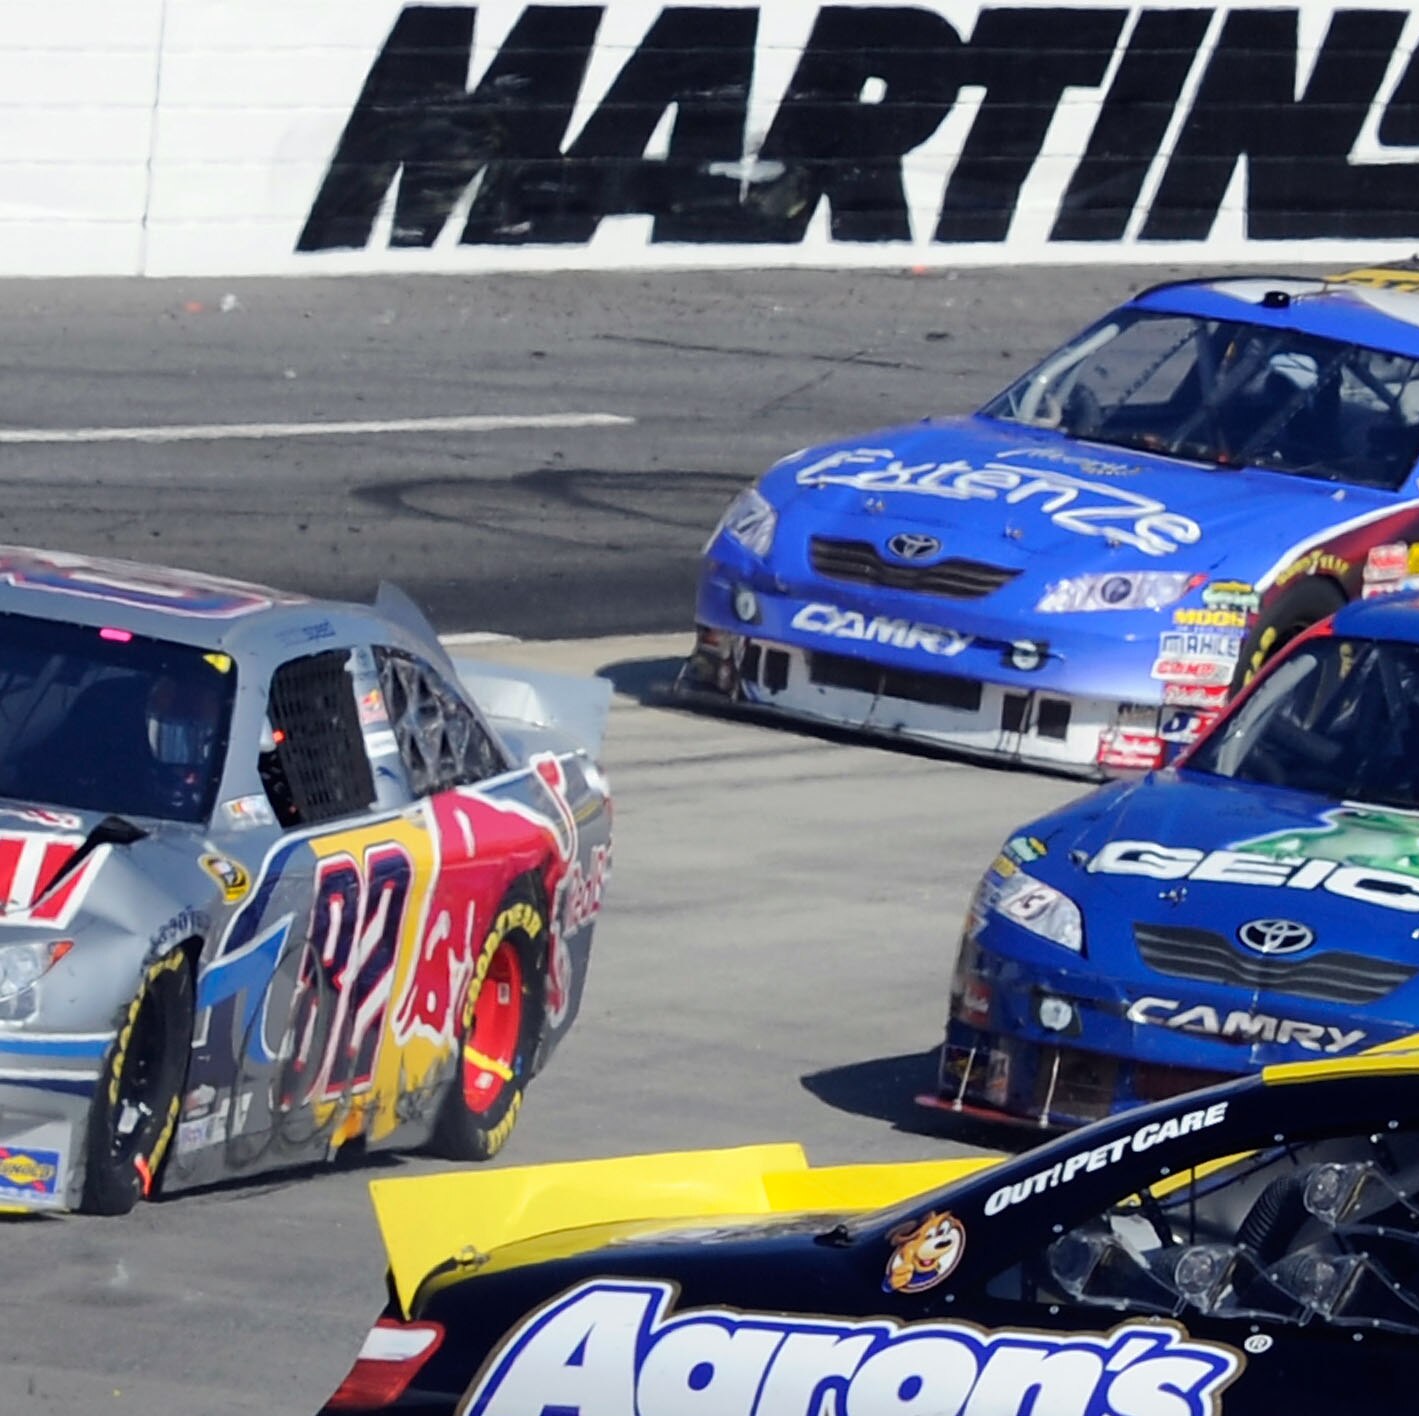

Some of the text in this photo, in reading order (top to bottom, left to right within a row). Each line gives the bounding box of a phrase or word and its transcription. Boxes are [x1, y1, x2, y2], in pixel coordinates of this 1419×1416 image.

[792, 603, 977, 657] CAMRY
[1163, 634, 1239, 658] MAHLE
[1126, 996, 1368, 1054] CAMRY
[985, 1102, 1228, 1216] OUT! PET CARE
